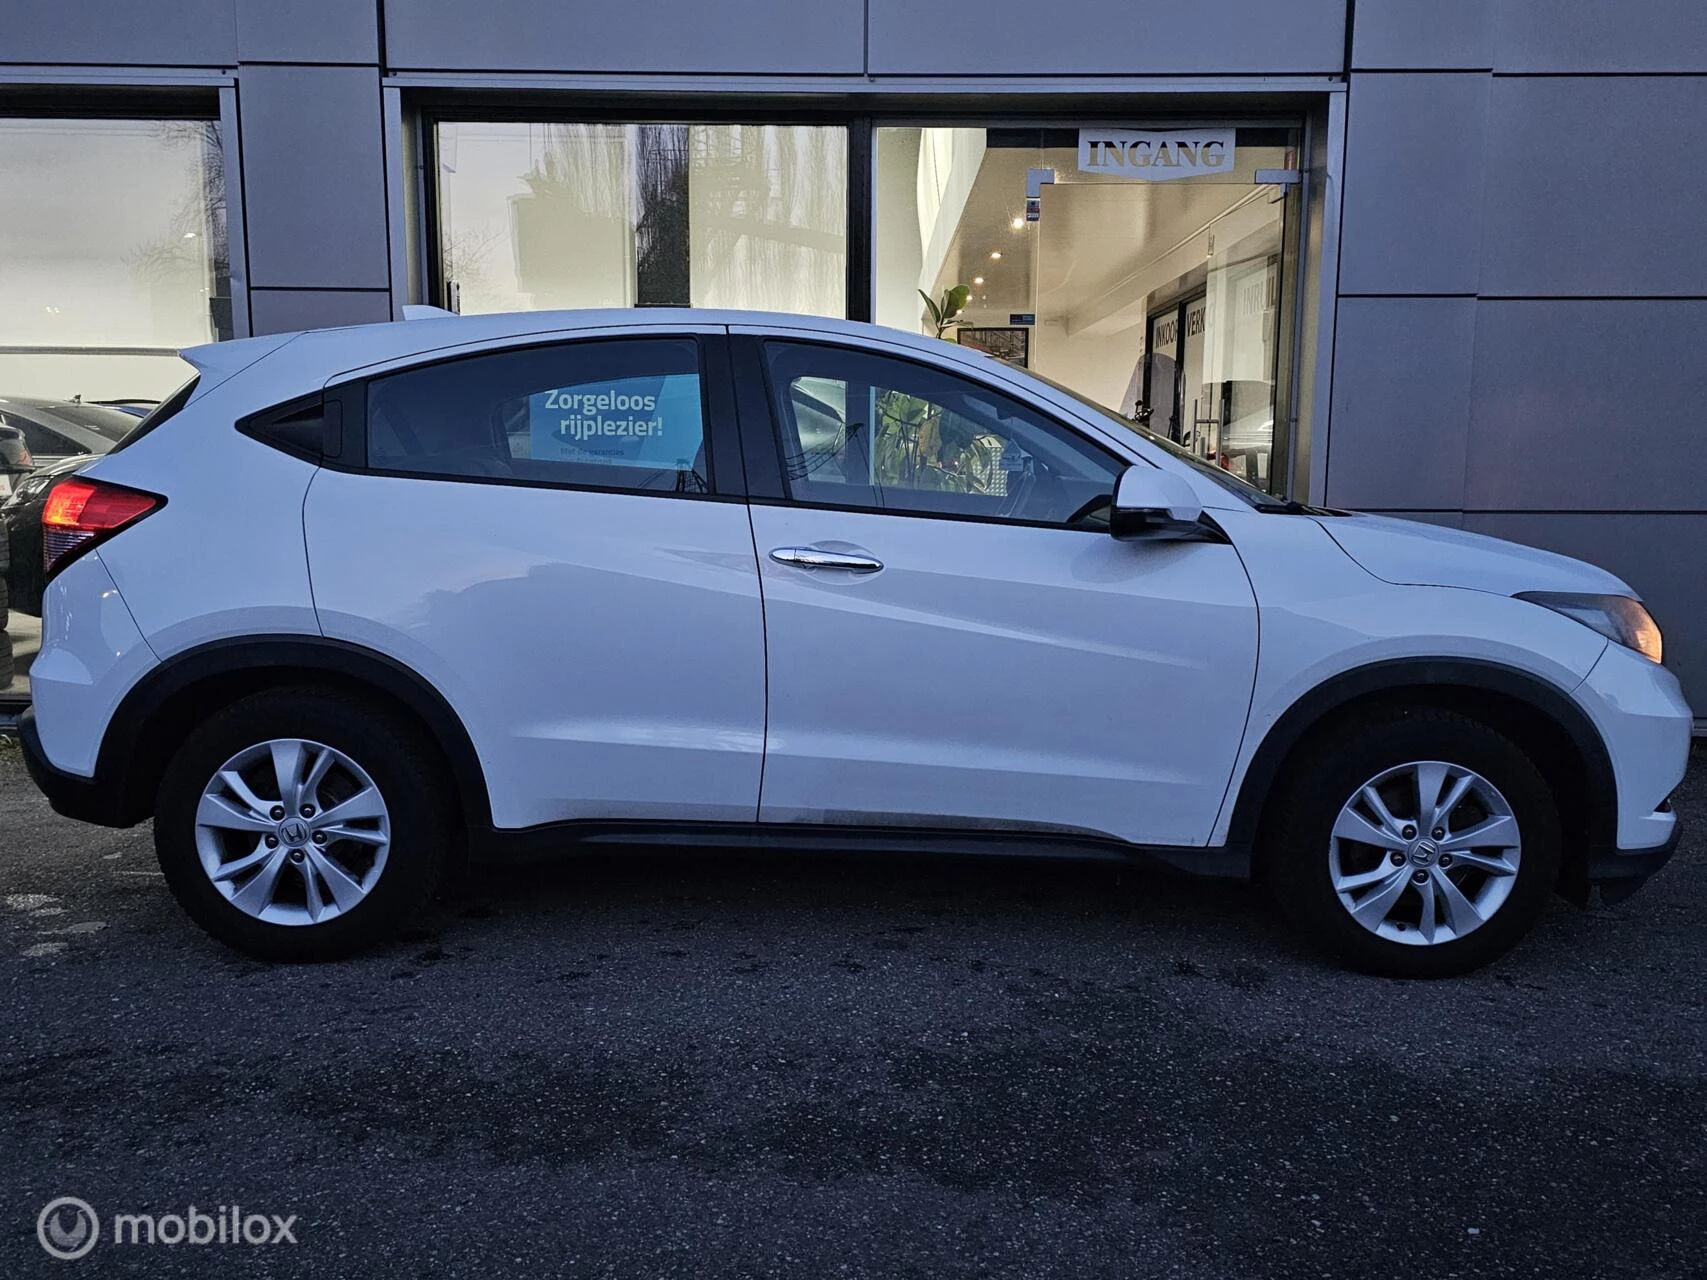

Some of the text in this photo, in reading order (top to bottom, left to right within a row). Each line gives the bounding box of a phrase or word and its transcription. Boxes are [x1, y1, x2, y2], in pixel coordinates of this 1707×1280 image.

[1087, 140, 1226, 168] INGANG
[544, 389, 656, 415] Zorgeloos
[560, 415, 664, 440] rijplezier!
